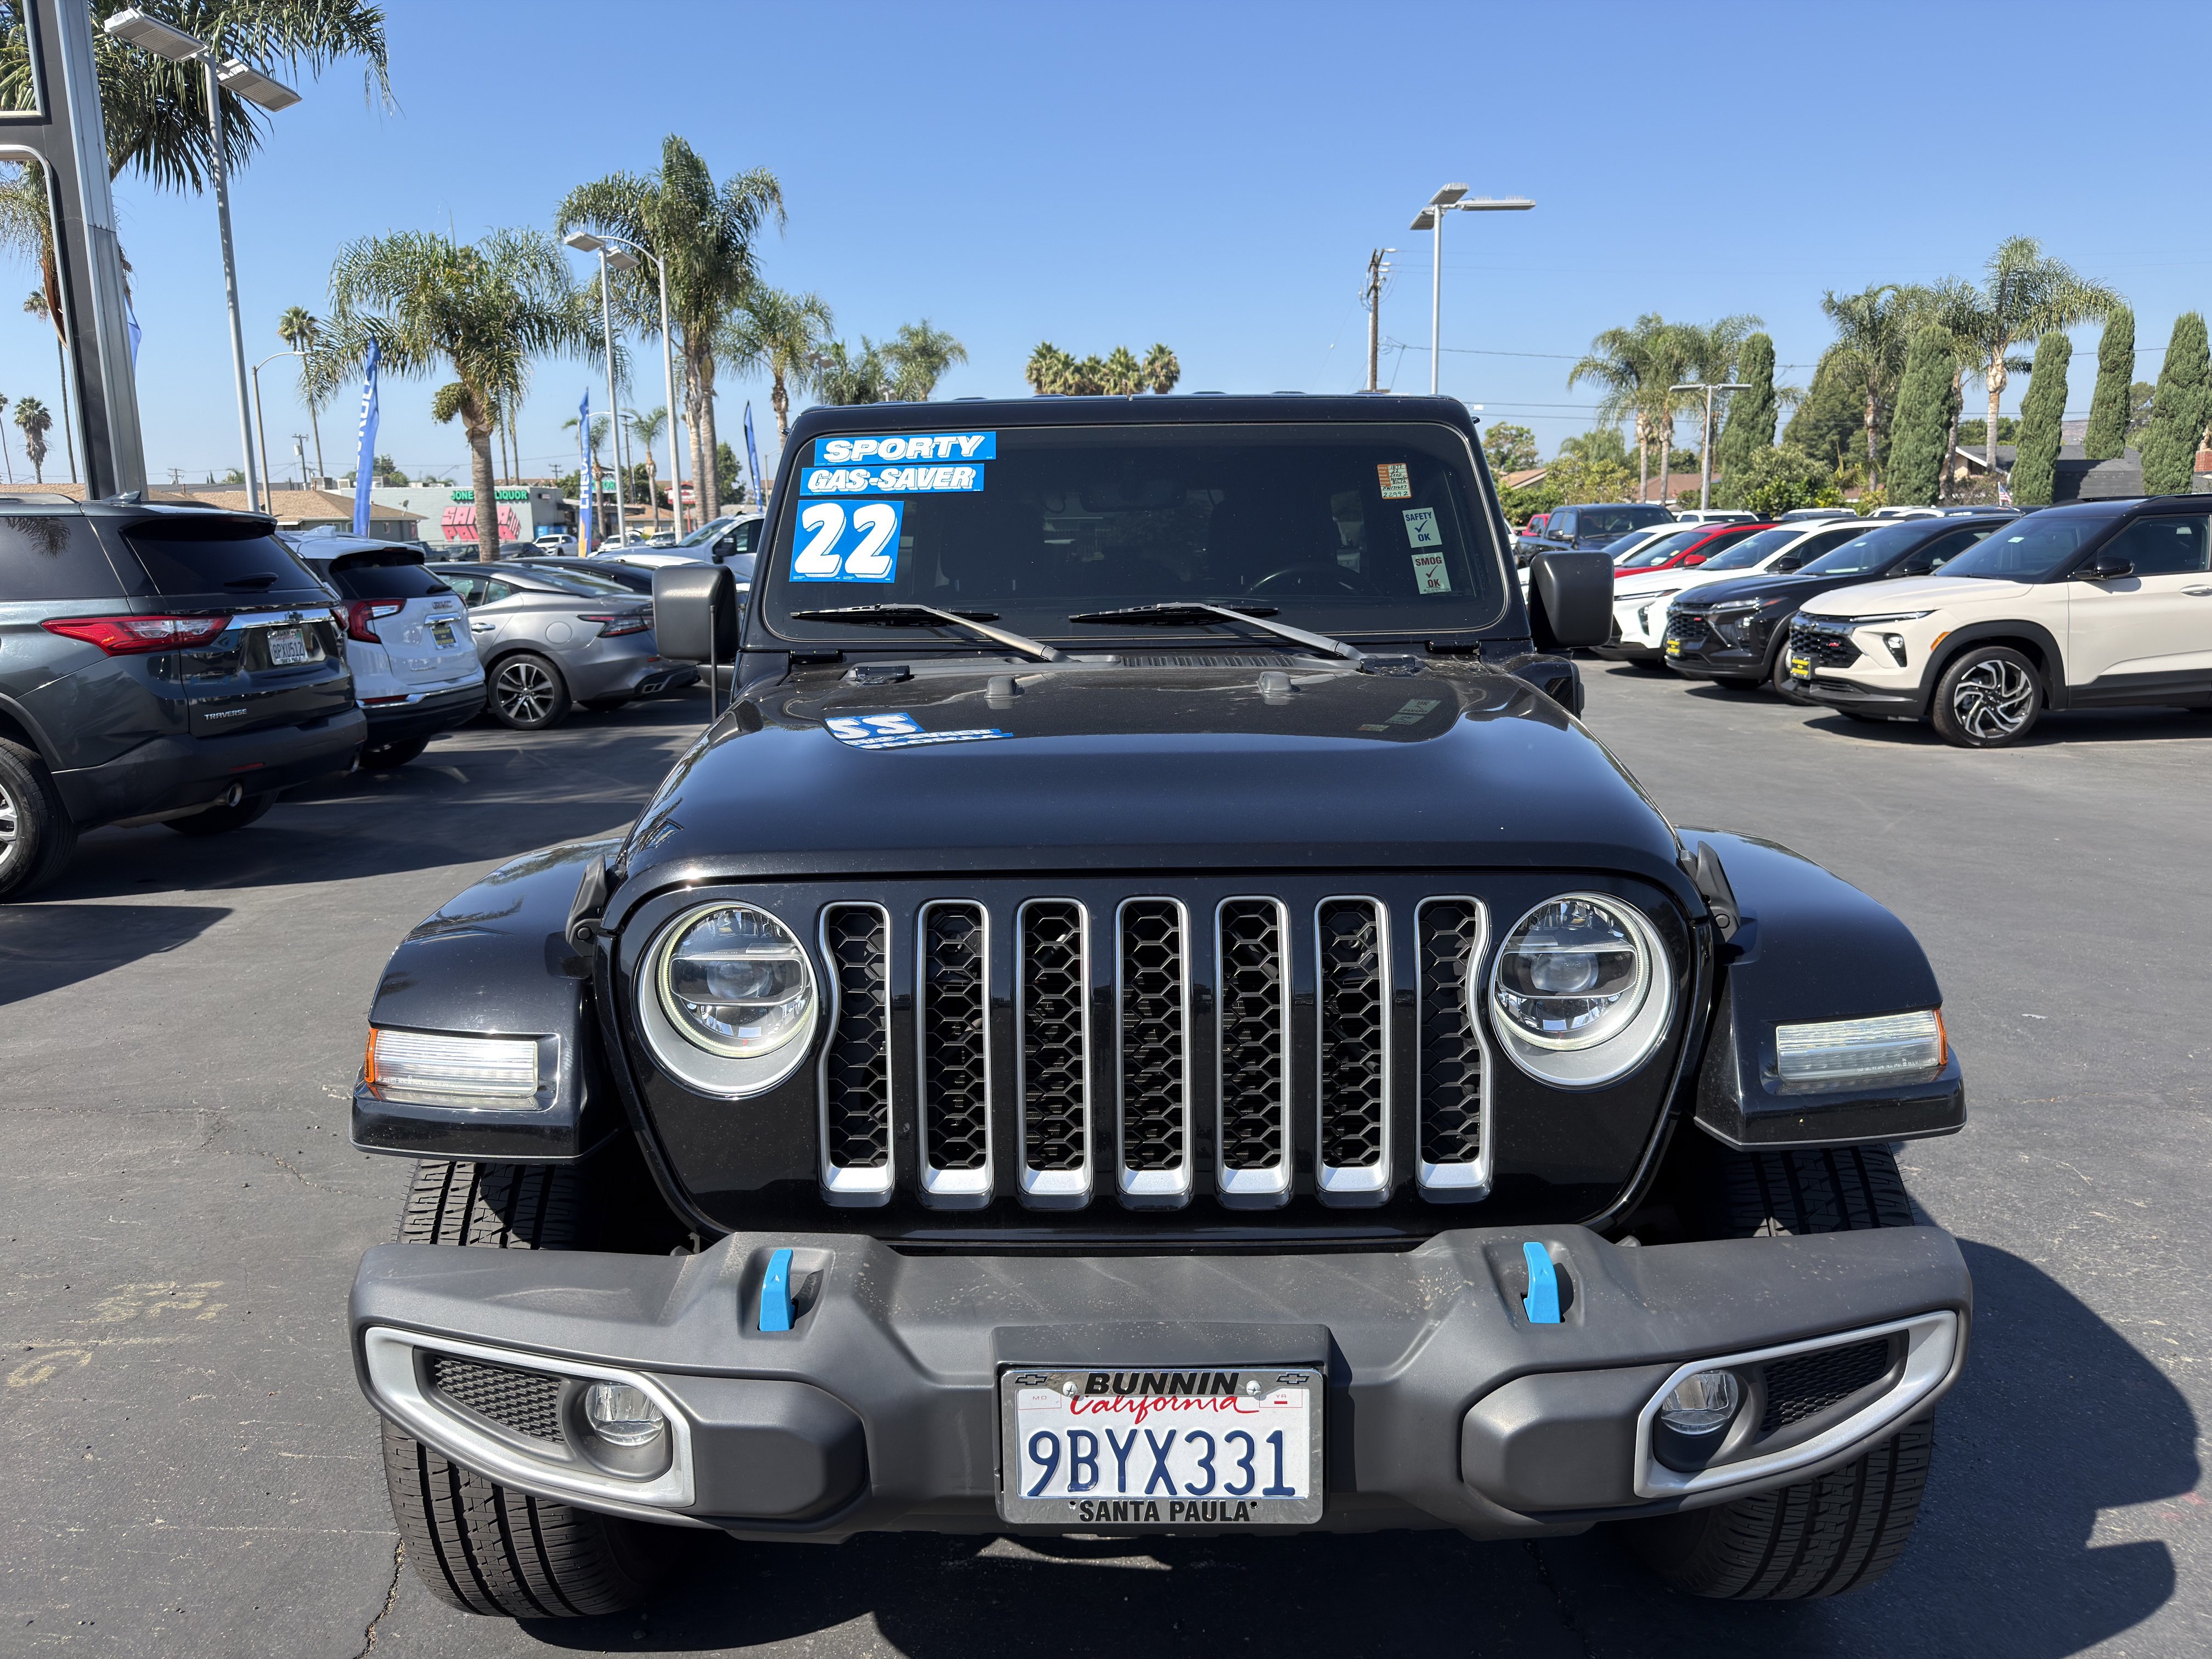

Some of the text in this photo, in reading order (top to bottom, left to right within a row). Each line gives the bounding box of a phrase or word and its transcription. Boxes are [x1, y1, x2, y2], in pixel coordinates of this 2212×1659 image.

[823, 435, 985, 462] SPORTY
[808, 466, 977, 493] GAS-SAVER
[450, 490, 474, 500] JONE
[494, 490, 528, 501] LIQUOR
[1406, 512, 1431, 521] SAFETY
[794, 502, 898, 579] 22
[1418, 533, 1431, 541] OK
[1415, 556, 1442, 566] SMOG
[1427, 579, 1441, 588] OK
[273, 641, 303, 659] 8PXU512
[204, 708, 247, 720] TRAVERSE
[1084, 1372, 1239, 1395] BUNNIN
[1070, 1395, 1260, 1424] California
[1027, 1429, 1295, 1497] 9BYX331
[1079, 1500, 1250, 1522] SANTA PAULA
